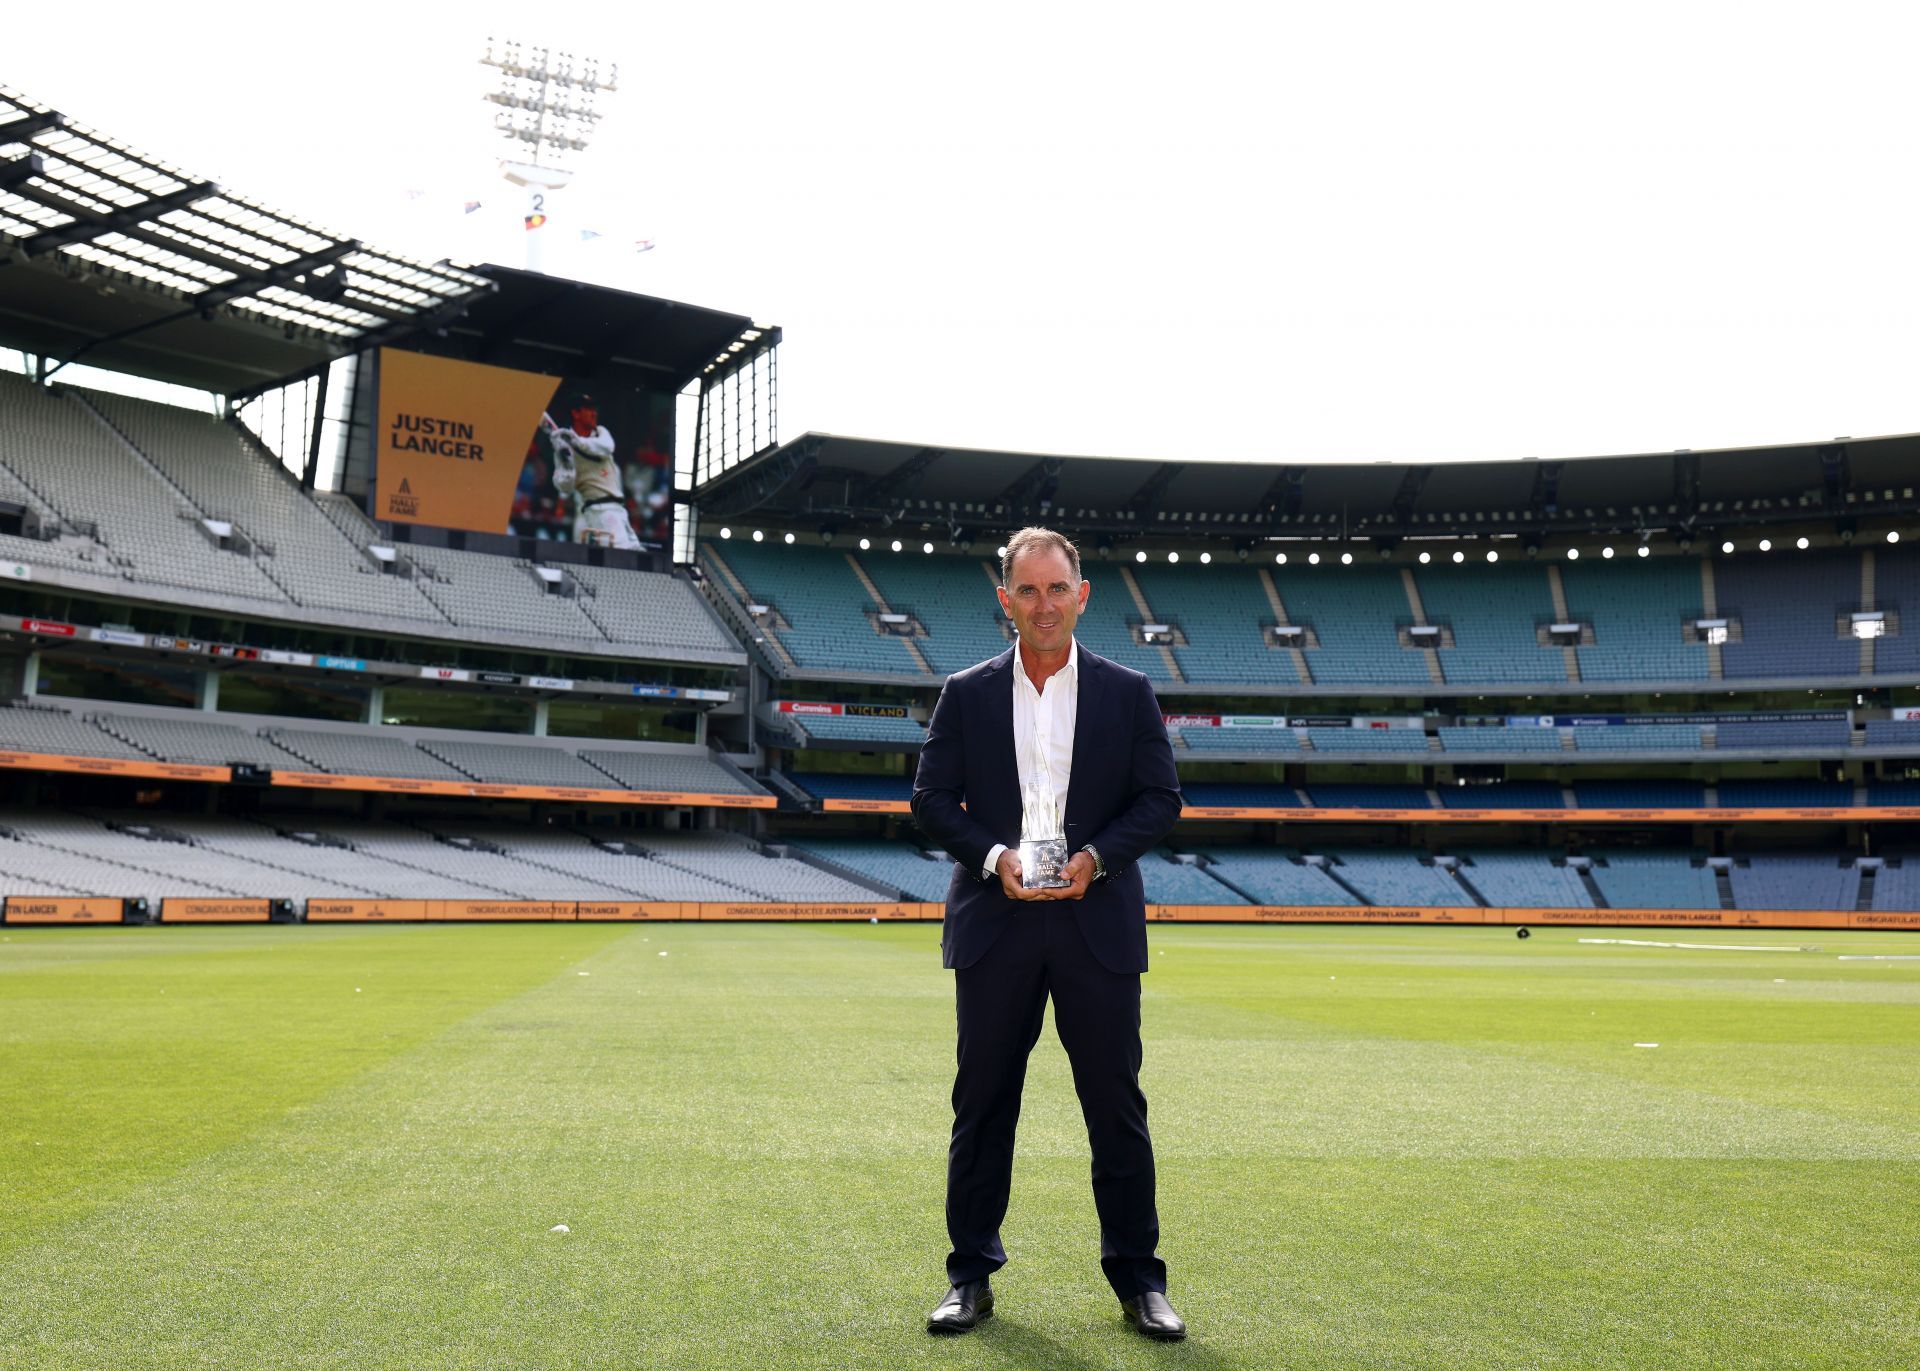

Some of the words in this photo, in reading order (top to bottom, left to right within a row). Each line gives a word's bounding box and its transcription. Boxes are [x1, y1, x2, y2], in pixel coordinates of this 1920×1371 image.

[533, 194, 544, 211] 2
[391, 413, 474, 440] JUSTIN
[391, 433, 484, 461] LANGER
[792, 703, 832, 714] Cummins
[850, 705, 904, 717] VICLAND
[1165, 716, 1213, 727] Ladbrokes
[23, 904, 58, 915] LANGER
[726, 907, 788, 915] CONGRATULATIONS
[789, 907, 823, 916] INDUCTEE
[825, 907, 849, 915] JUSTIN
[850, 907, 877, 915] LANGER
[1255, 909, 1325, 918] CONGRATULATIONS
[1390, 910, 1420, 918] LANGER
[1542, 911, 1617, 920] CONGRATULATIONS
[1618, 912, 1658, 921] INDUCTEE
[1659, 912, 1687, 921] JUSTIN
[1688, 912, 1722, 922] LANGER
